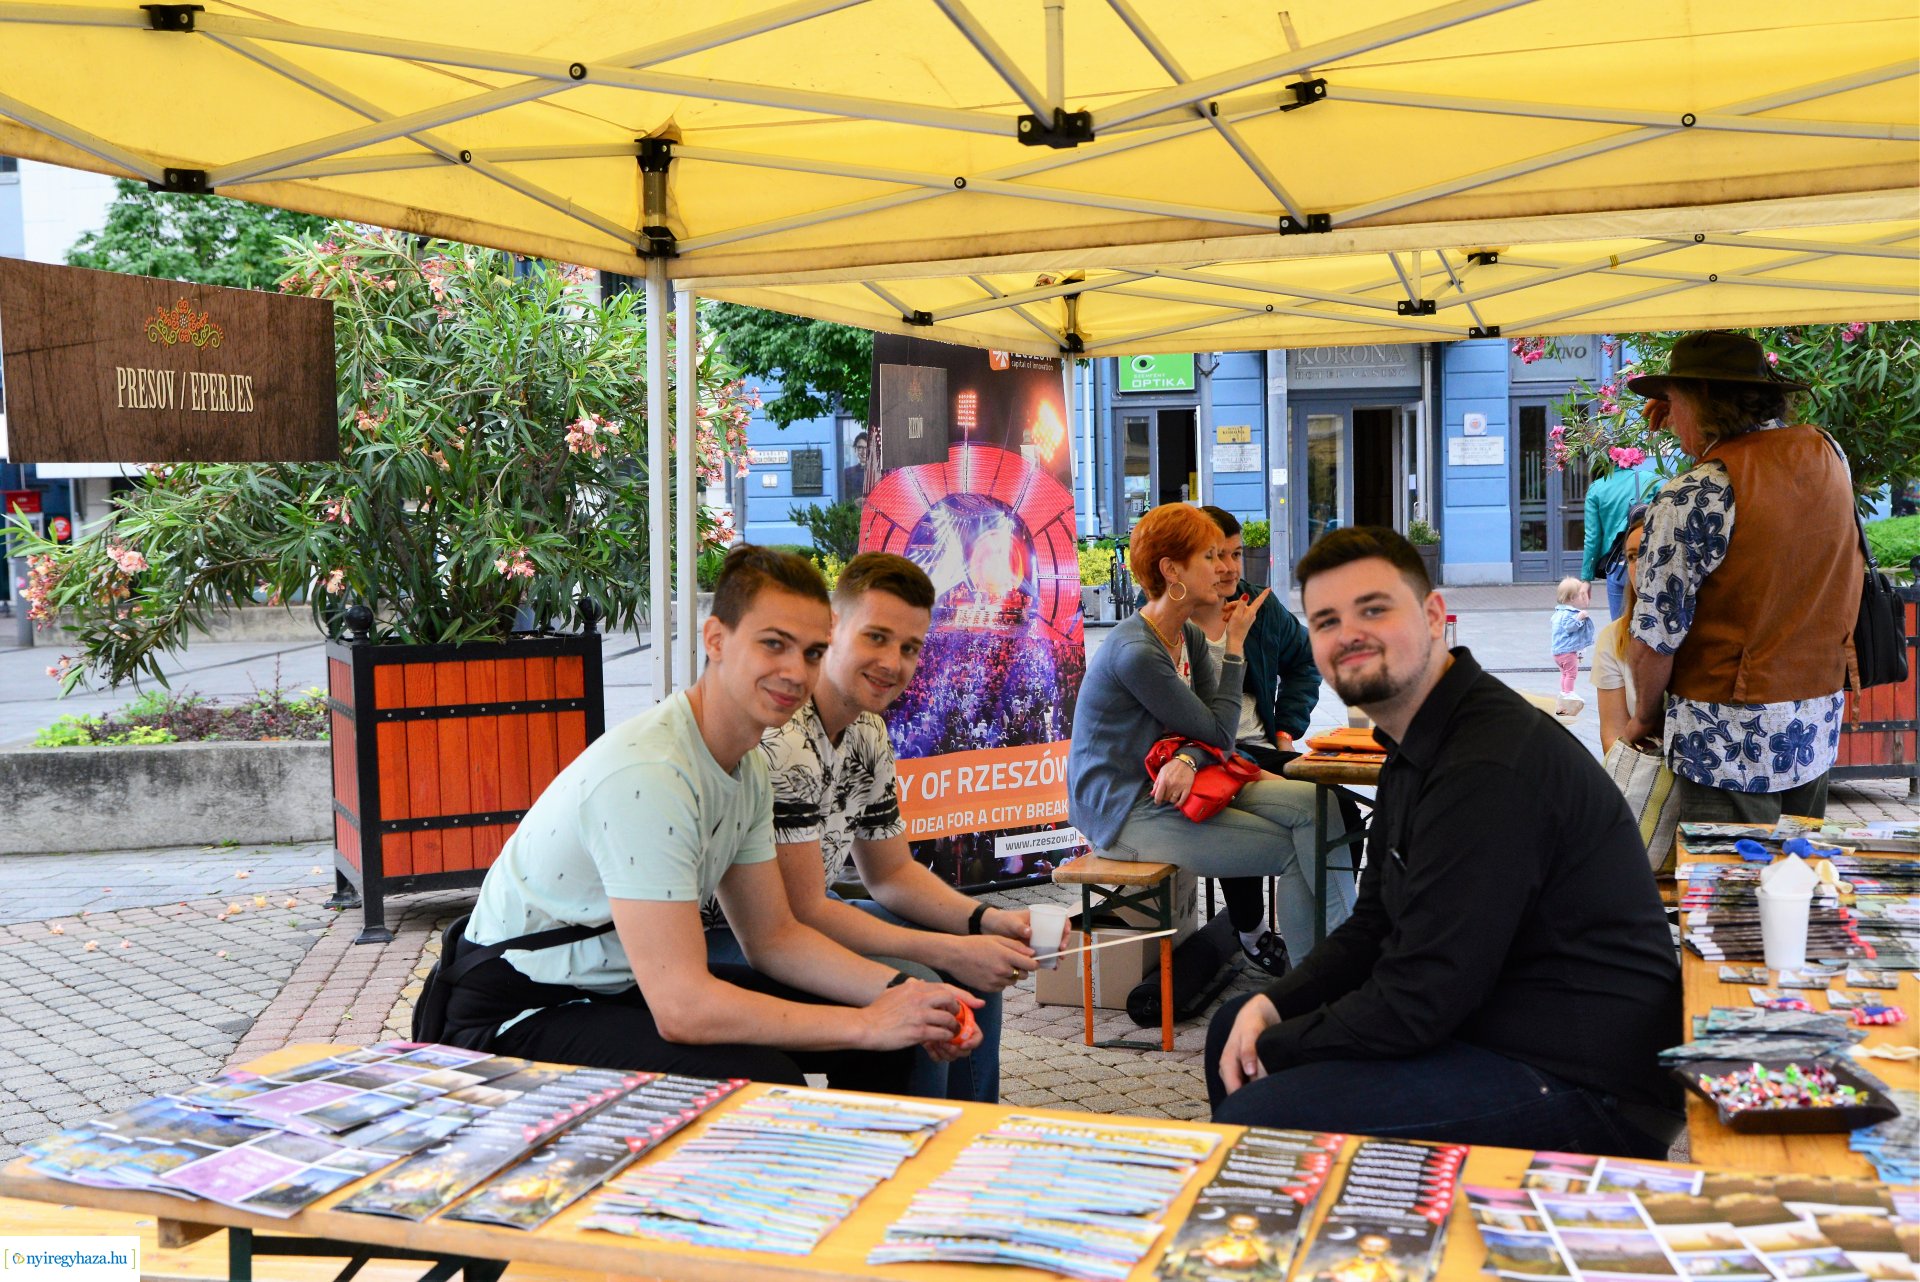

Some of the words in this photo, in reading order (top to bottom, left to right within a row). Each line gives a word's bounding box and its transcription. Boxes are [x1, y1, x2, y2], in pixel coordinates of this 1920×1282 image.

[1027, 361, 1032, 369] of
[1296, 344, 1405, 365] KORONA
[115, 366, 175, 410] PRESOV
[180, 371, 187, 410] /
[190, 371, 255, 413] EPERJES
[1132, 378, 1186, 388] OPTIKA
[921, 769, 952, 800] OF
[957, 749, 1068, 795] RZESZÓW
[911, 815, 945, 835] IDEA
[947, 810, 974, 829] FOR
[977, 808, 988, 825] A
[991, 804, 1023, 823] CITY
[1026, 798, 1069, 820] BREAK
[1005, 830, 1077, 852] www.rzeszow.pl
